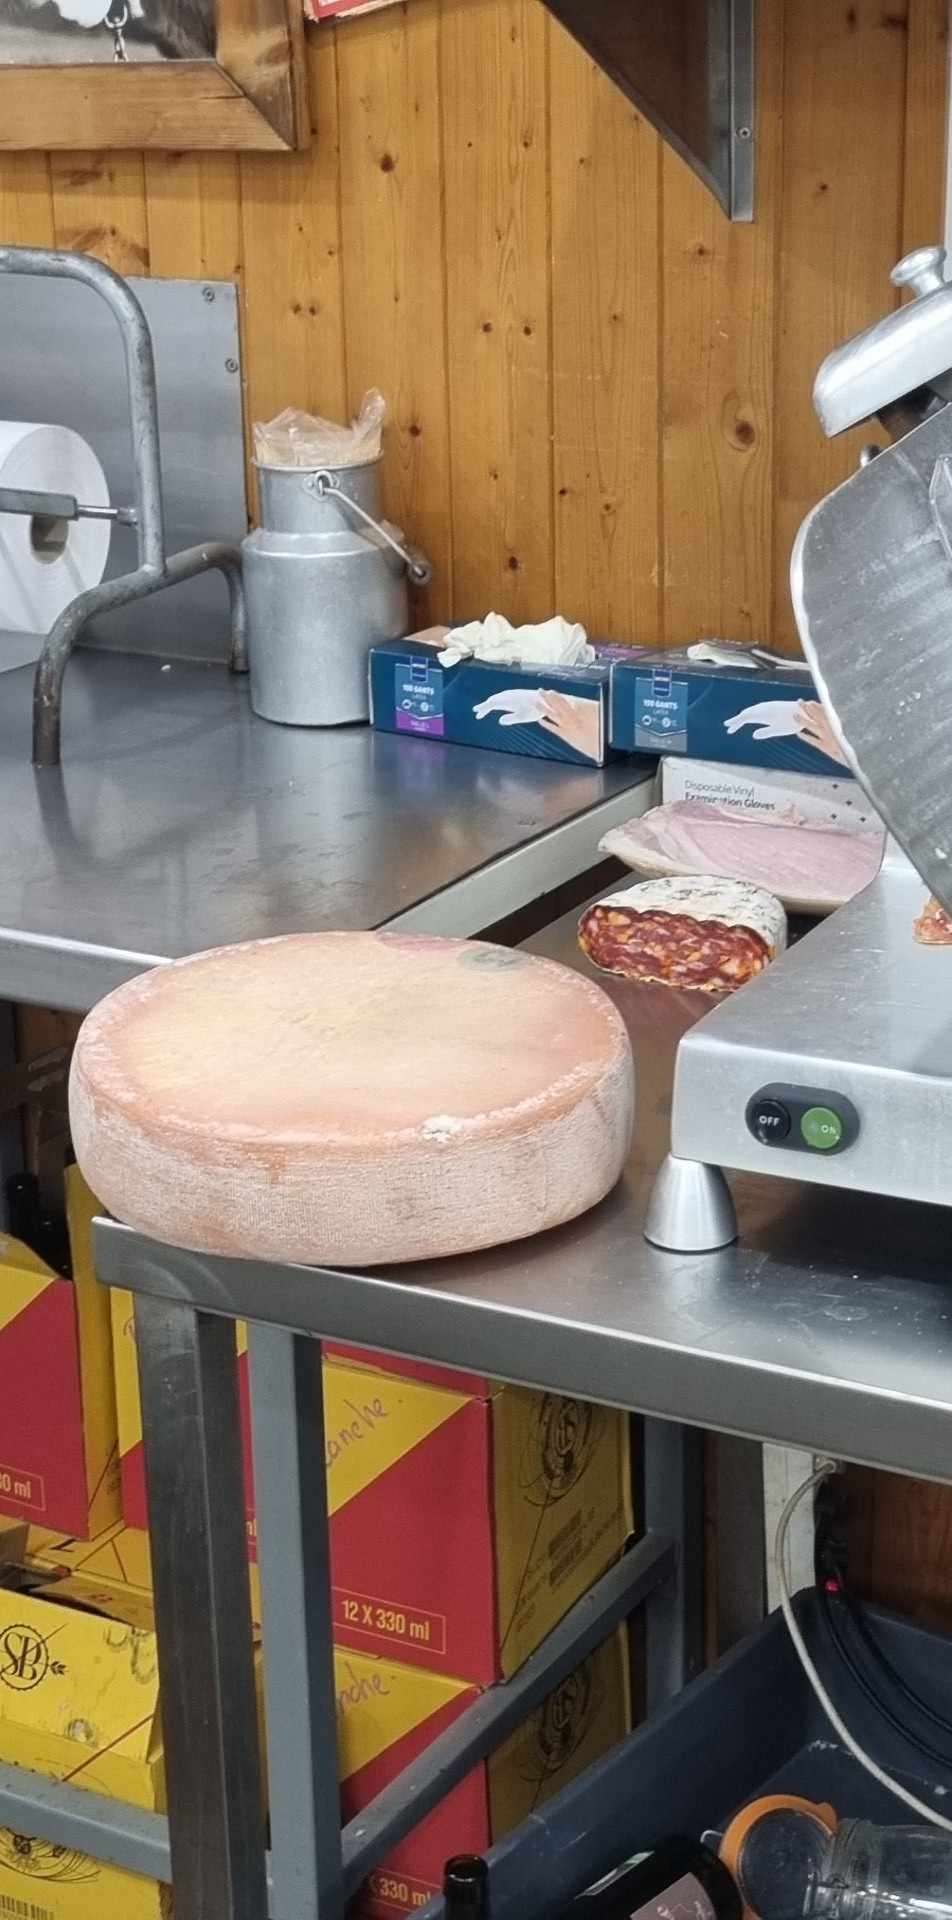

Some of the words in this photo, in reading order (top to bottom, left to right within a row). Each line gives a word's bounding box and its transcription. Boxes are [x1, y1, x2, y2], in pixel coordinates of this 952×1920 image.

[655, 700, 678, 710] GANTS
[684, 780, 732, 793] Disposable
[733, 786, 755, 797] Vinyl
[744, 799, 775, 809] Gloves
[759, 1115, 780, 1126] OFF
[14, 1480, 31, 1499] ml
[342, 1600, 359, 1621] 12
[376, 1608, 406, 1634] 330
[409, 1621, 430, 1641] ml
[379, 1878, 409, 1903] 330
